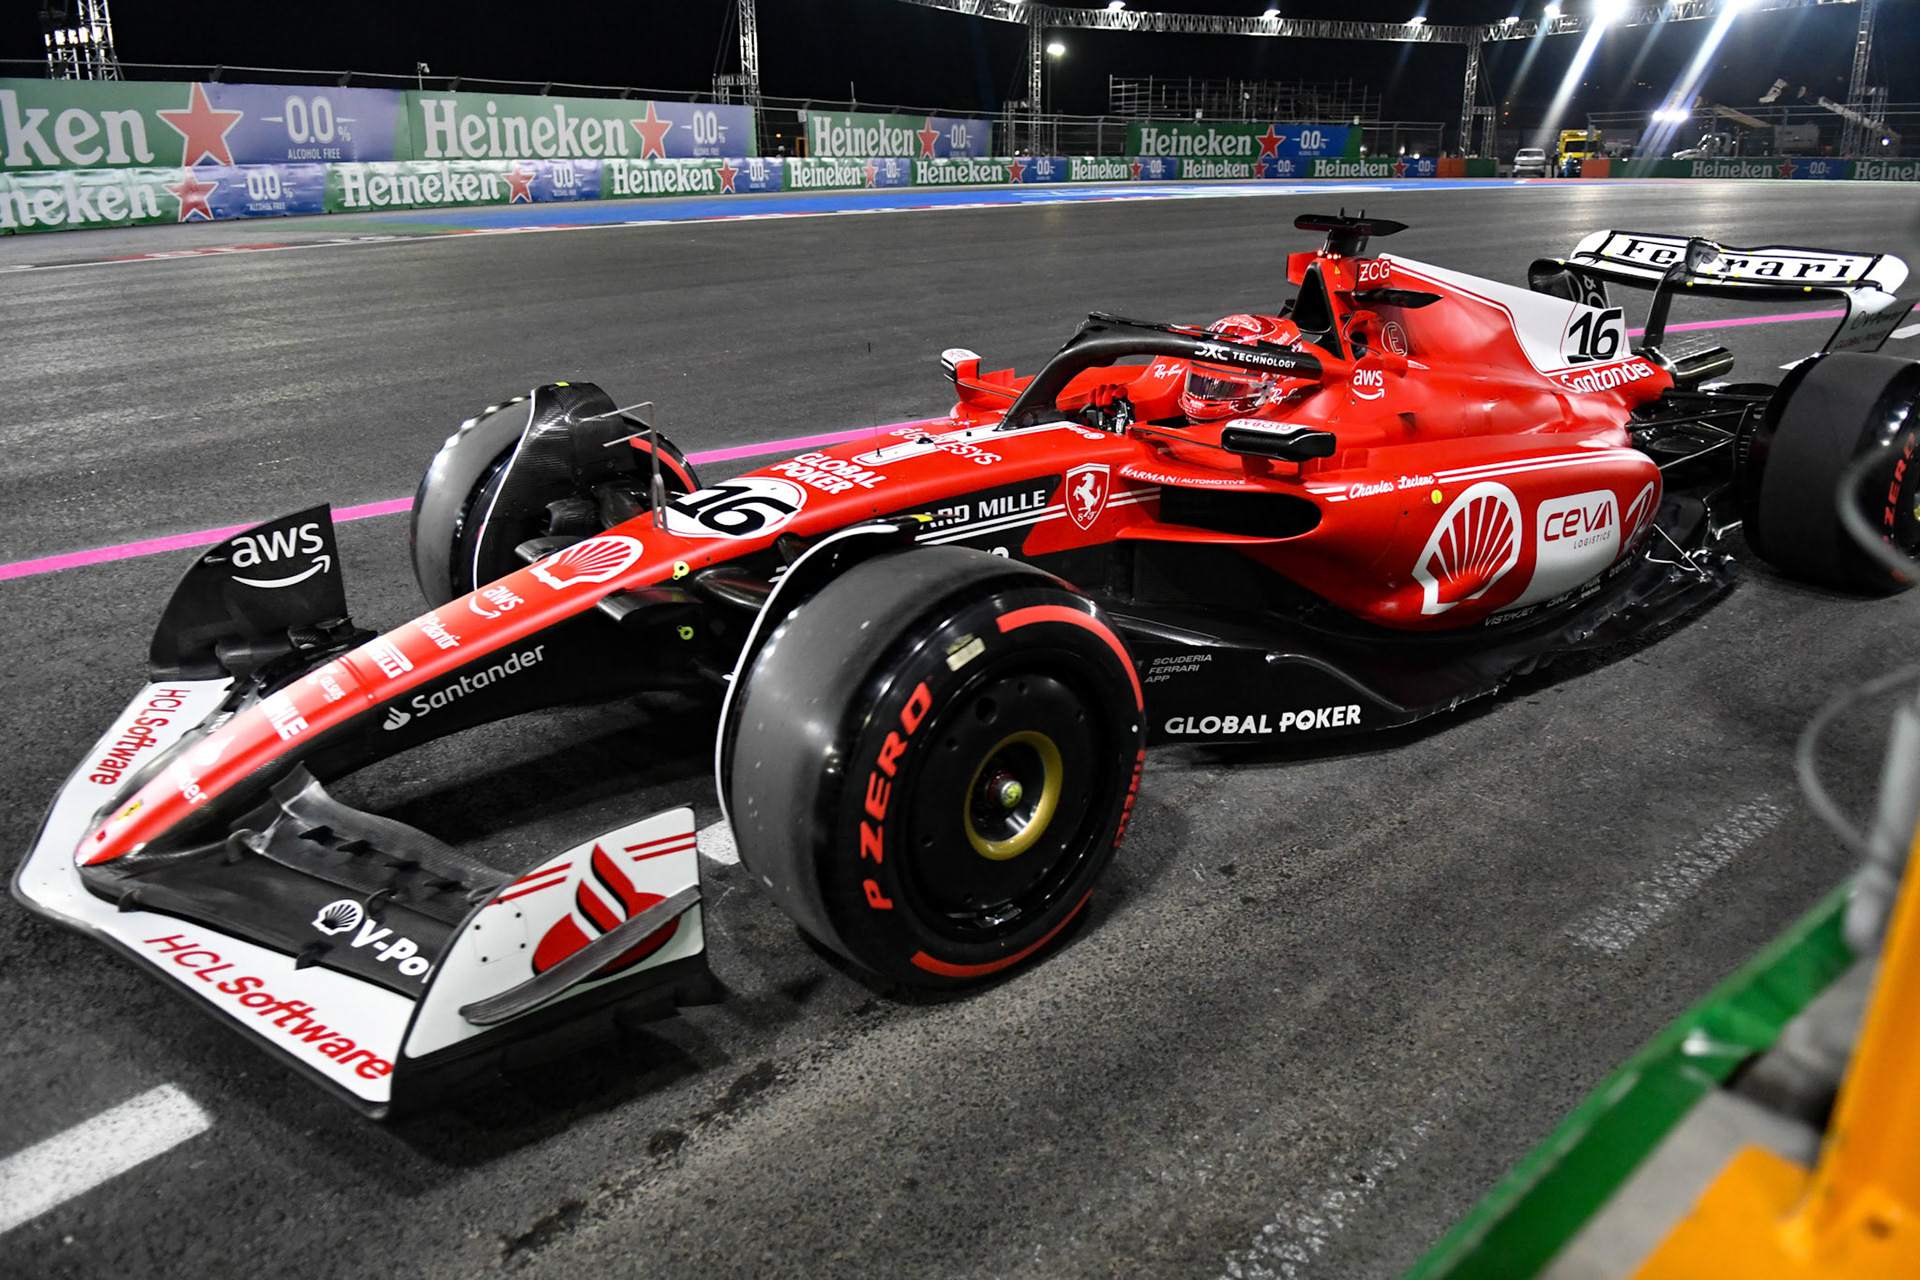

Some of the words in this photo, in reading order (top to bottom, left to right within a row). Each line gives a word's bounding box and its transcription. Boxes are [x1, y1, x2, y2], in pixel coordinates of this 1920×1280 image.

[0, 89, 155, 166] ken
[420, 100, 629, 158] Heineken
[813, 116, 915, 157] Heineken
[1140, 128, 1251, 156] Heineken
[288, 148, 321, 160] ALCOHOL
[323, 148, 341, 160] FREE
[1182, 159, 1249, 178] Heineken
[1314, 158, 1389, 177] Heineken
[343, 161, 500, 207] Heineken
[612, 163, 715, 194] Heineken
[790, 161, 862, 188] Heineken
[916, 160, 1003, 184] Heineken
[1071, 160, 1128, 180] Heineken
[1691, 161, 1773, 178] Heineken
[273, 202, 286, 210] FREE
[1359, 261, 1391, 282] ZCG
[1616, 238, 1857, 280] Ferari
[1567, 308, 1623, 364] 16
[1195, 341, 1230, 360] DXC
[1232, 351, 1297, 370] TECHNOLOGY
[1353, 369, 1384, 387] aws
[1560, 360, 1655, 394] Santander
[771, 461, 855, 494] POKER
[794, 452, 887, 489] GLOBAL
[1120, 466, 1176, 484] HARMAN
[1181, 477, 1246, 486] AUTOMOTIVE
[1349, 480, 1394, 500] Charles
[1397, 474, 1435, 490] Leclerc
[667, 485, 802, 536] 16
[919, 504, 970, 530] ARD
[979, 490, 1046, 519] MILLE
[231, 522, 324, 568] aws
[1573, 530, 1611, 550] LOGISTICS
[482, 584, 525, 612] aws
[1149, 664, 1200, 674] FERRARI
[1152, 653, 1212, 666] SCUDERIA
[411, 644, 546, 717] Santander
[1144, 675, 1170, 684] APP
[1164, 714, 1273, 734] GLOBAL
[1279, 704, 1362, 733] POKER
[89, 688, 191, 786] HCLSoftware
[860, 681, 933, 865] ZERO
[863, 878, 893, 911] P
[351, 919, 436, 984] V-Po
[143, 934, 395, 1080] HCLSoftware
